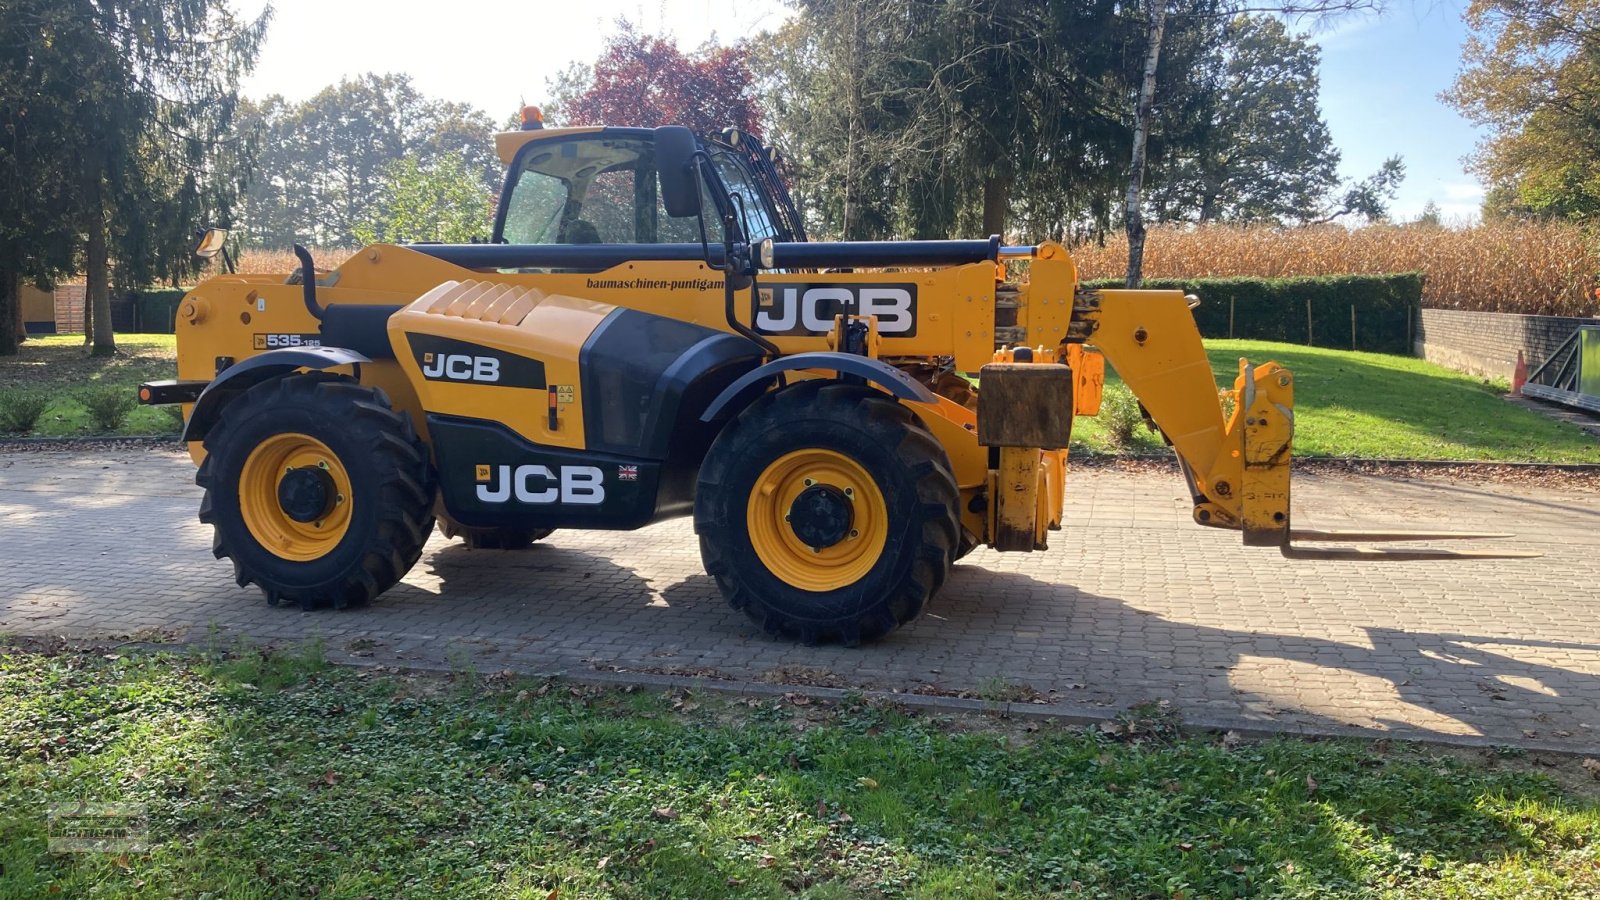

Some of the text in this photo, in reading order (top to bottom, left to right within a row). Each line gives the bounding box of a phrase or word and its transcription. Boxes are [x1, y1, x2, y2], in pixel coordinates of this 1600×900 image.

[587, 278, 725, 291] baumaschinen-puntigam
[756, 288, 913, 332] JCB
[423, 353, 500, 382] JCB
[476, 464, 605, 504] JCB
